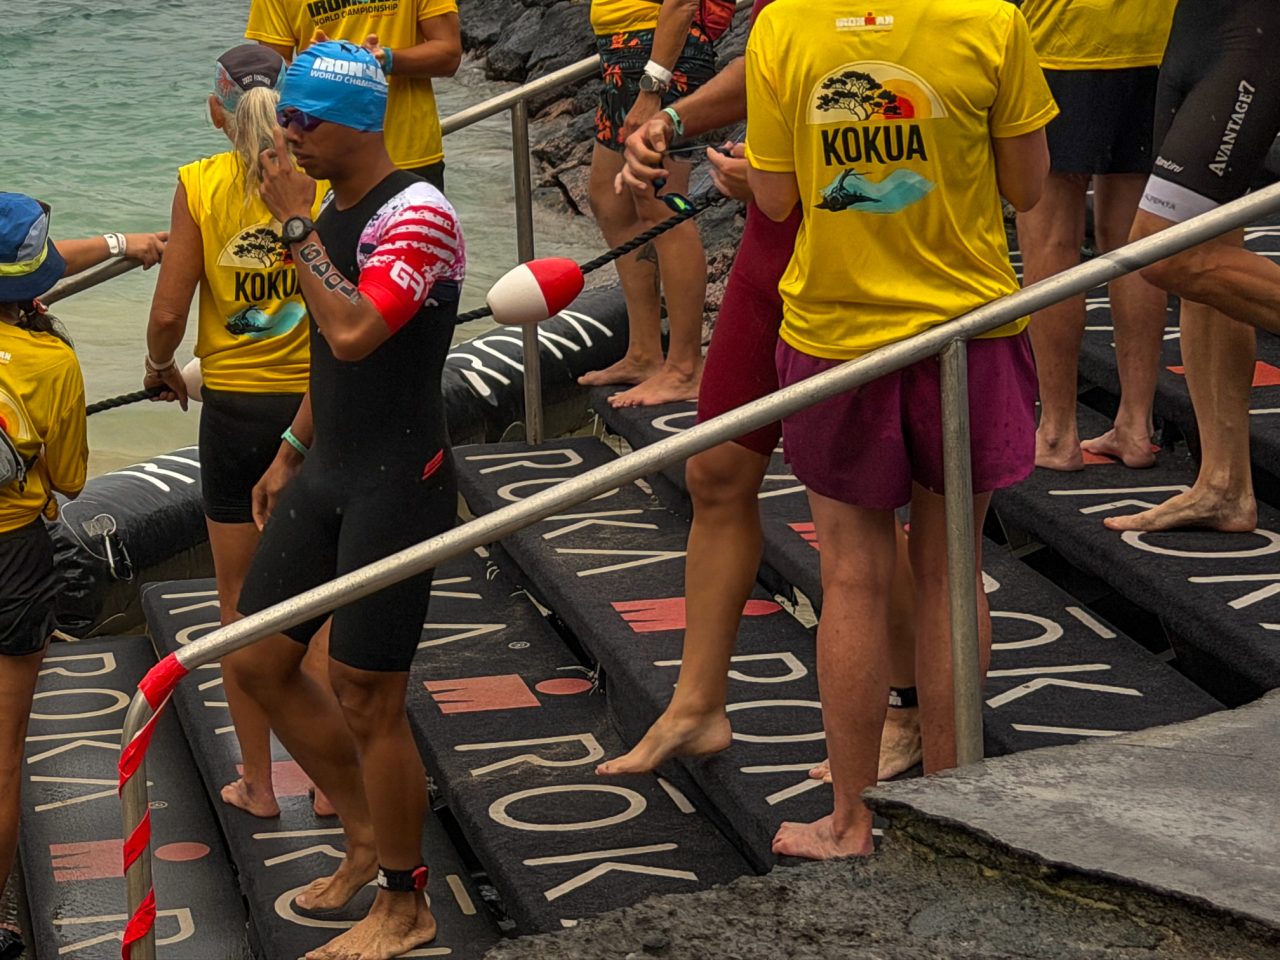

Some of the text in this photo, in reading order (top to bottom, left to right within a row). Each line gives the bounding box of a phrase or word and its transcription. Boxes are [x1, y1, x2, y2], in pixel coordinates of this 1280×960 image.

[310, 69, 343, 82] WORLD
[820, 123, 929, 167] KOKUA
[234, 269, 301, 302] KOKU
[453, 732, 700, 928] RŌK
